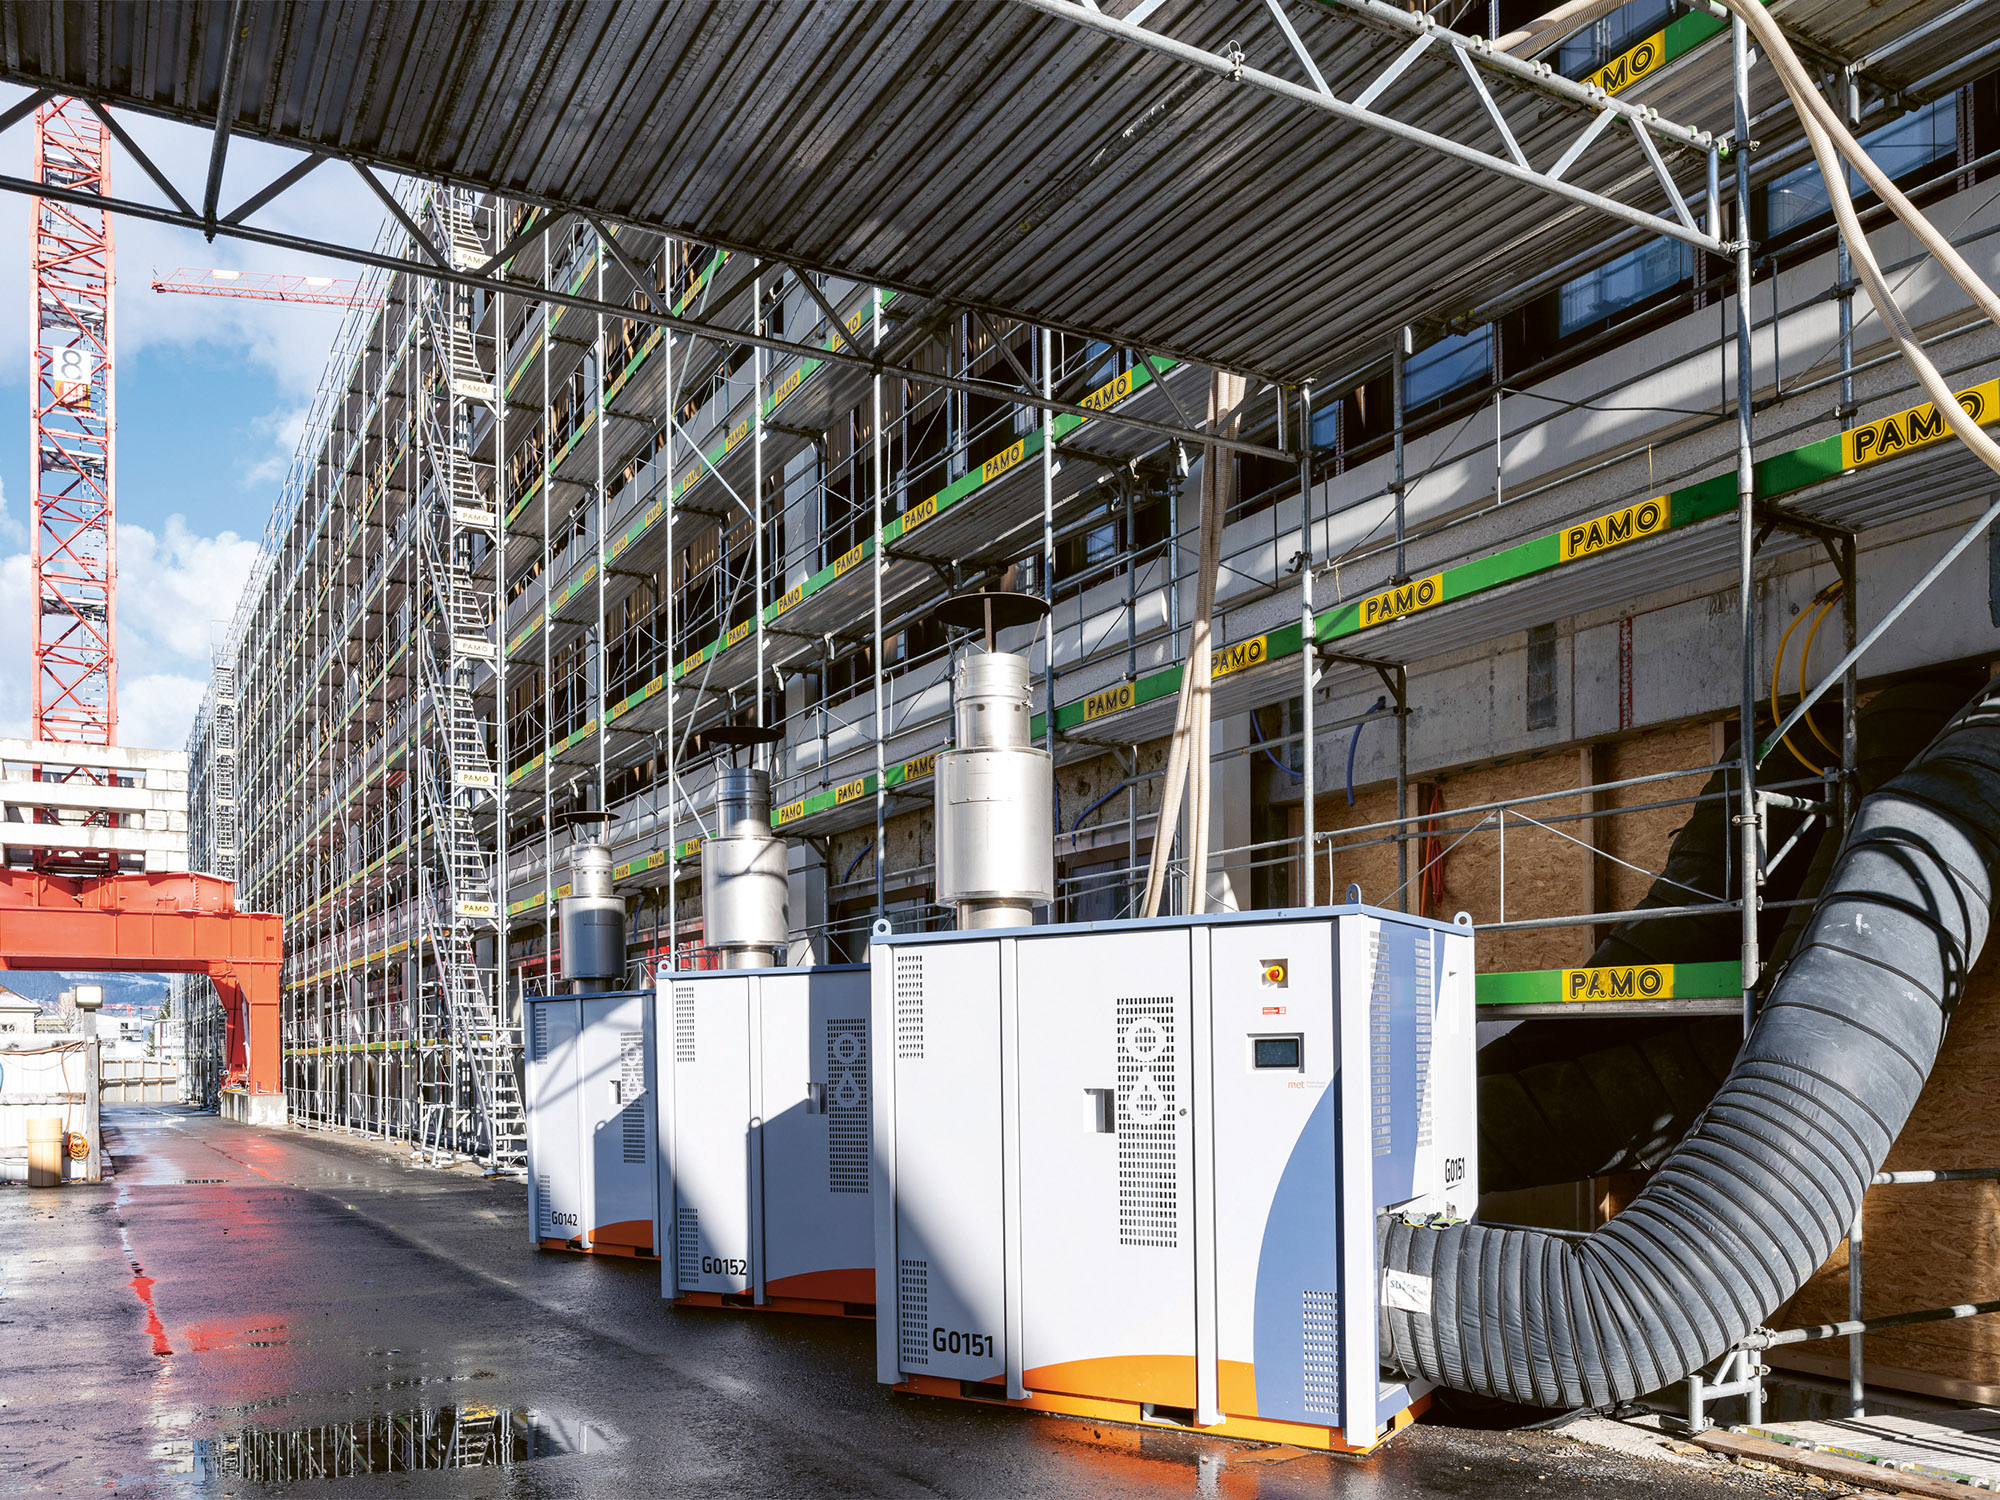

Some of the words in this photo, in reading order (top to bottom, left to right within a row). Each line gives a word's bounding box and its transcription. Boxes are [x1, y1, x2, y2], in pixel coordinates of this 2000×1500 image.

[462, 254, 487, 264] PAMO
[684, 280, 700, 307] PAMO
[646, 331, 660, 355] PAMO
[61, 350, 82, 380] 8
[462, 384, 487, 393] PAMO
[613, 372, 625, 396] PAMO
[777, 374, 798, 403] PAMO
[1085, 376, 1127, 409] PAMO
[728, 425, 746, 450] PAMO
[984, 444, 1020, 480] PAMO
[463, 513, 488, 521] PAMO
[646, 505, 661, 525] PAMO
[905, 503, 933, 530] PAMO
[1567, 502, 1661, 557] PAMO
[614, 538, 627, 556] PAMO
[836, 548, 860, 573] PAMO
[779, 589, 800, 612] PAMO
[1365, 579, 1435, 624] PAMO
[729, 623, 747, 644] PAMO
[463, 643, 488, 652] PAMO
[1211, 640, 1263, 676] PAMO
[685, 653, 701, 671] PAMO
[646, 679, 660, 695] PAMO
[614, 701, 627, 717] PAMO
[1087, 686, 1131, 718] PAMO
[464, 774, 489, 782] PAMO
[838, 782, 861, 803] PAMO
[781, 804, 801, 821] PAMO
[649, 852, 664, 868] PAMO
[615, 865, 630, 878] PAMO
[464, 905, 489, 913] PAMO
[1570, 968, 1663, 999] PAMO
[1288, 1081, 1304, 1089] met
[1445, 1157, 1464, 1183] G0151
[552, 1211, 577, 1226] G0142
[702, 1256, 747, 1275] G0152
[933, 1327, 993, 1357] G0151
